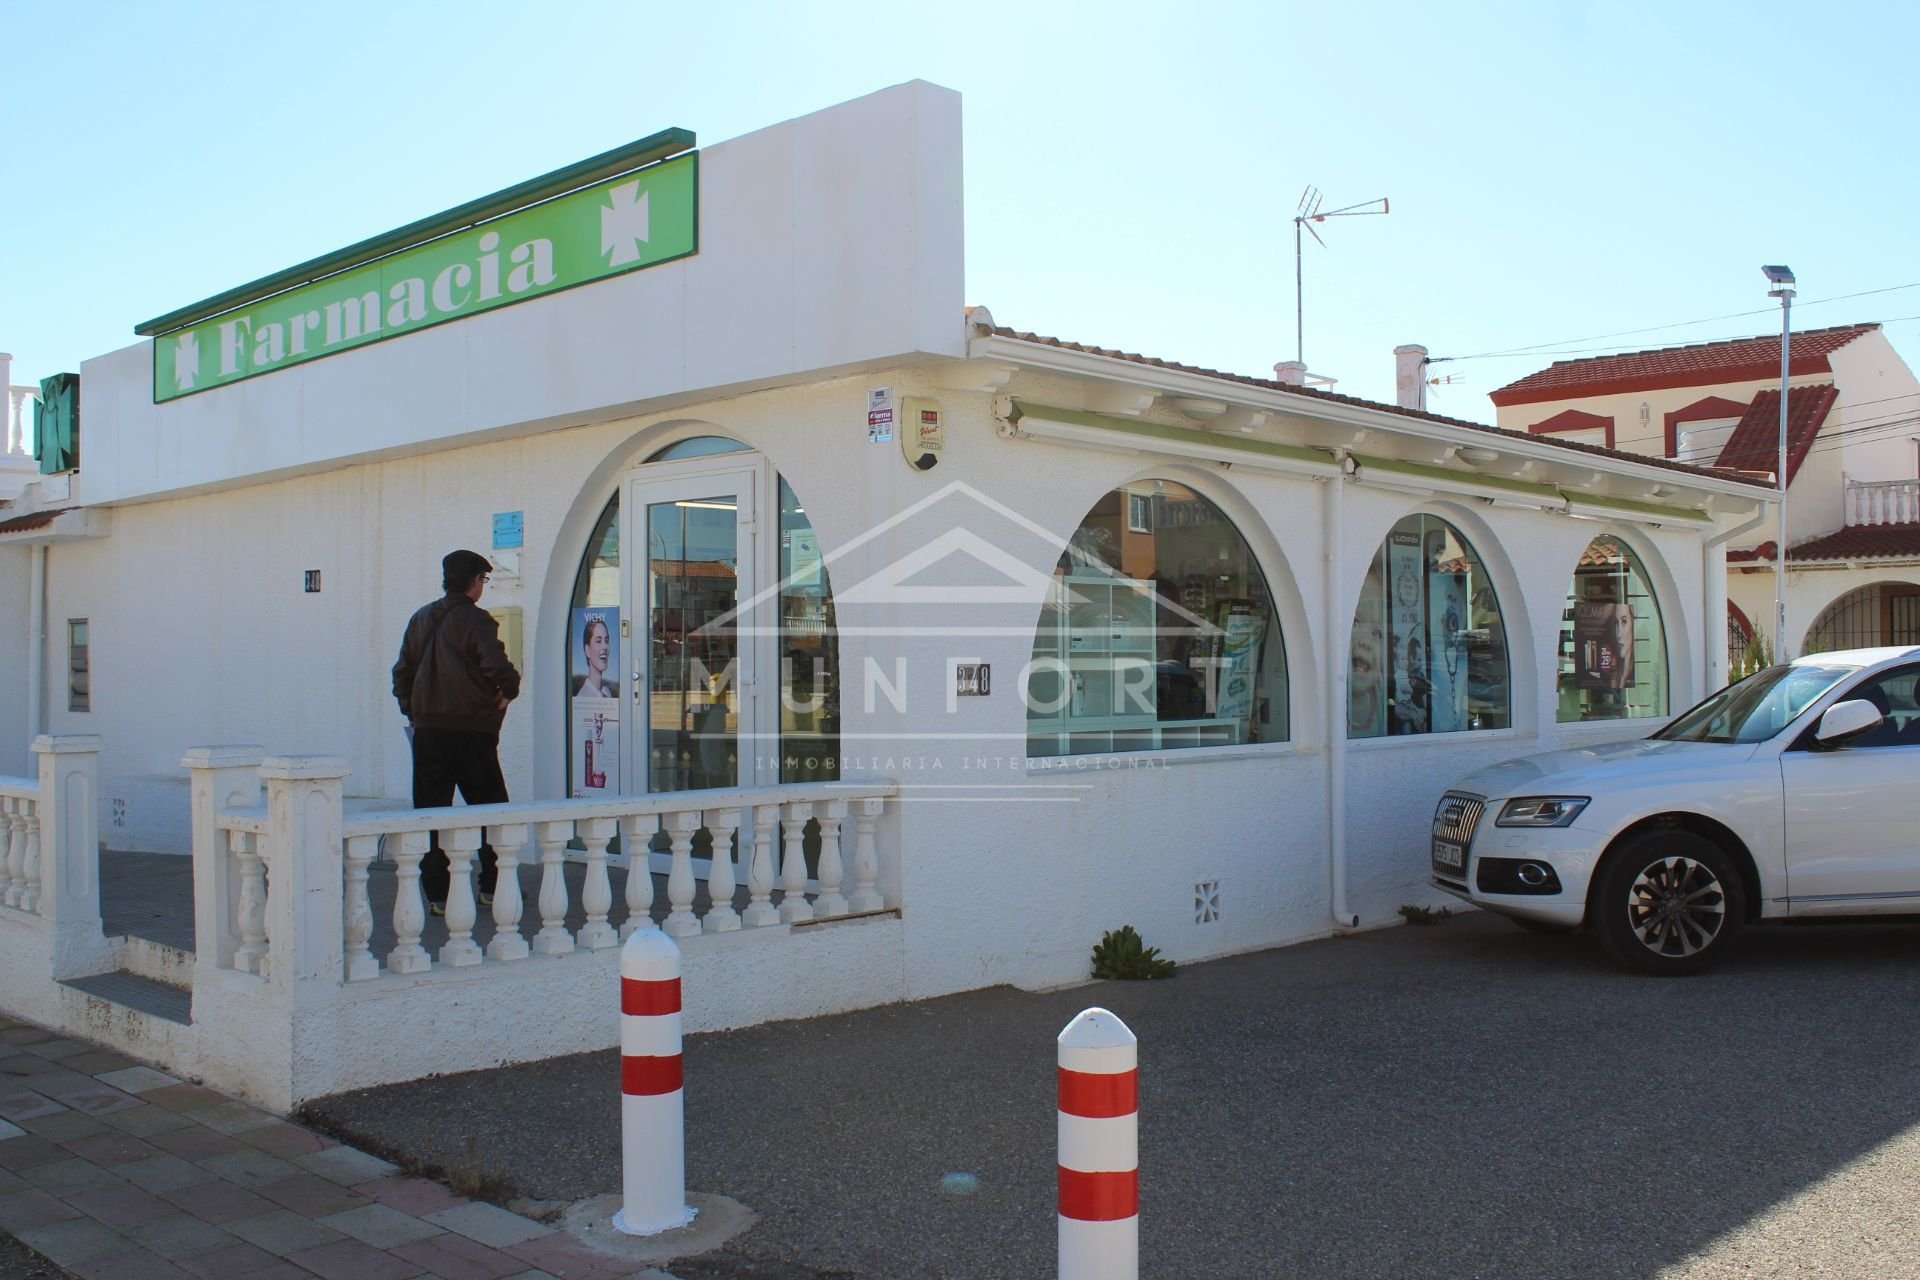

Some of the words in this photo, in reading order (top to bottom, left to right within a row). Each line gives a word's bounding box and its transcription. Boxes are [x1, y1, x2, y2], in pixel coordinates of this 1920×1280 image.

[217, 230, 557, 377] Farmacia
[584, 612, 606, 622] VICHY
[958, 666, 988, 693] 348
